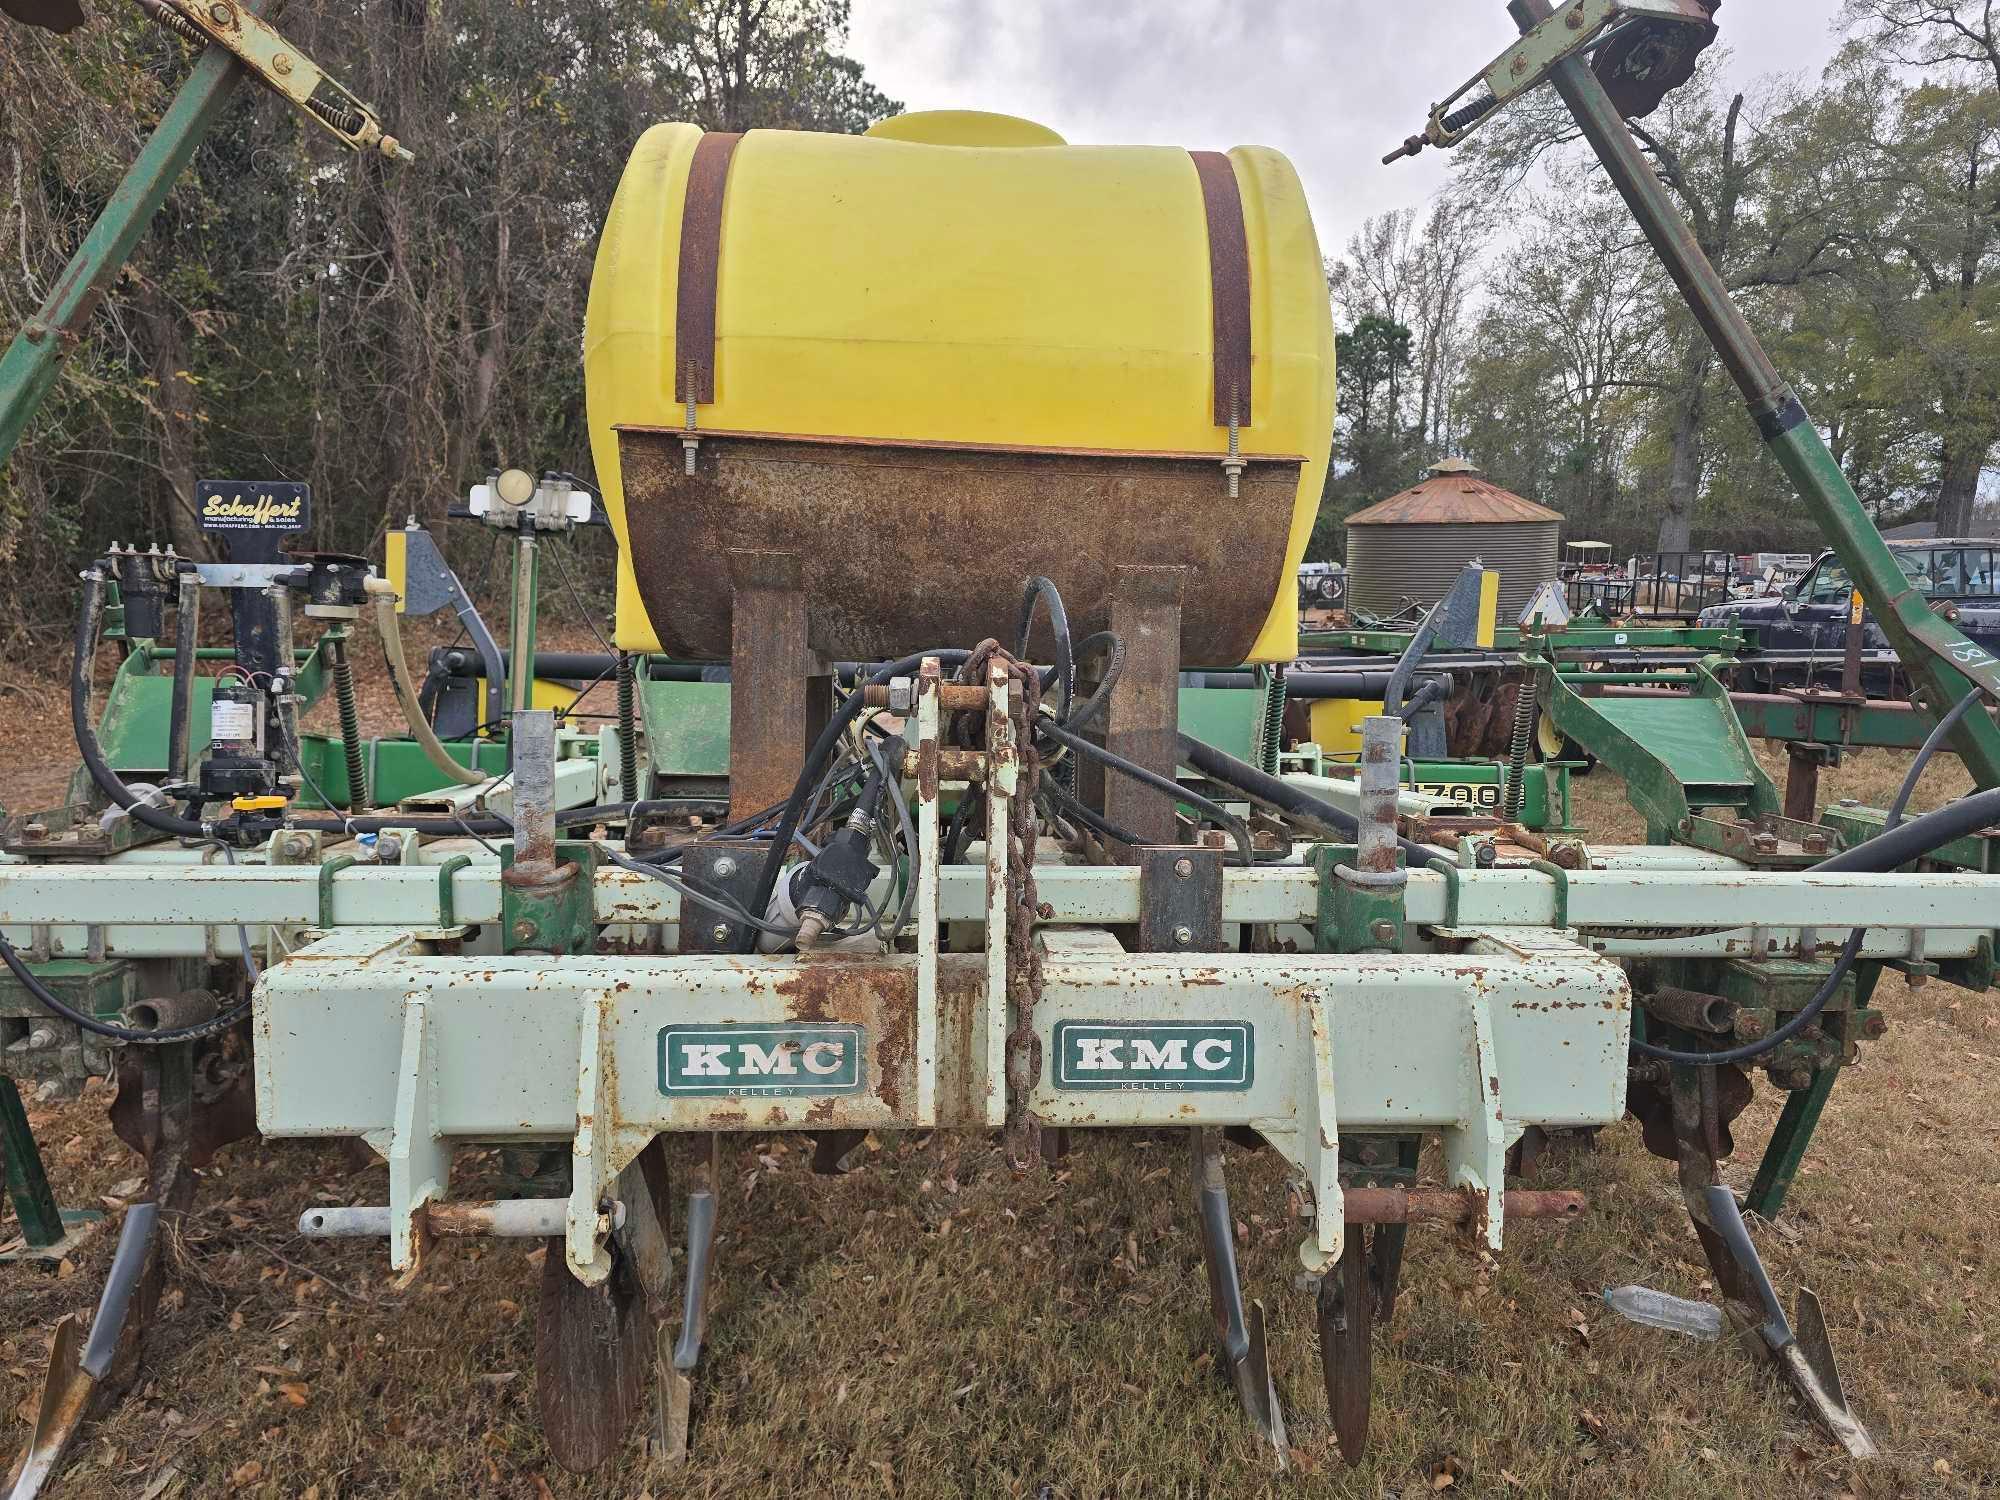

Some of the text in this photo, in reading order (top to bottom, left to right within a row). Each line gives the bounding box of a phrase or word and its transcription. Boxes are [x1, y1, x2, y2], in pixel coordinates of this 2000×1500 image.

[202, 494, 301, 524] Schaffert
[204, 515, 256, 524] manufacturing
[1412, 784, 1500, 807] 700
[681, 1041, 844, 1076] KMC
[1076, 1038, 1232, 1071] KMC
[728, 1087, 799, 1096] KELLEY
[1121, 1082, 1185, 1090] KELLEY
